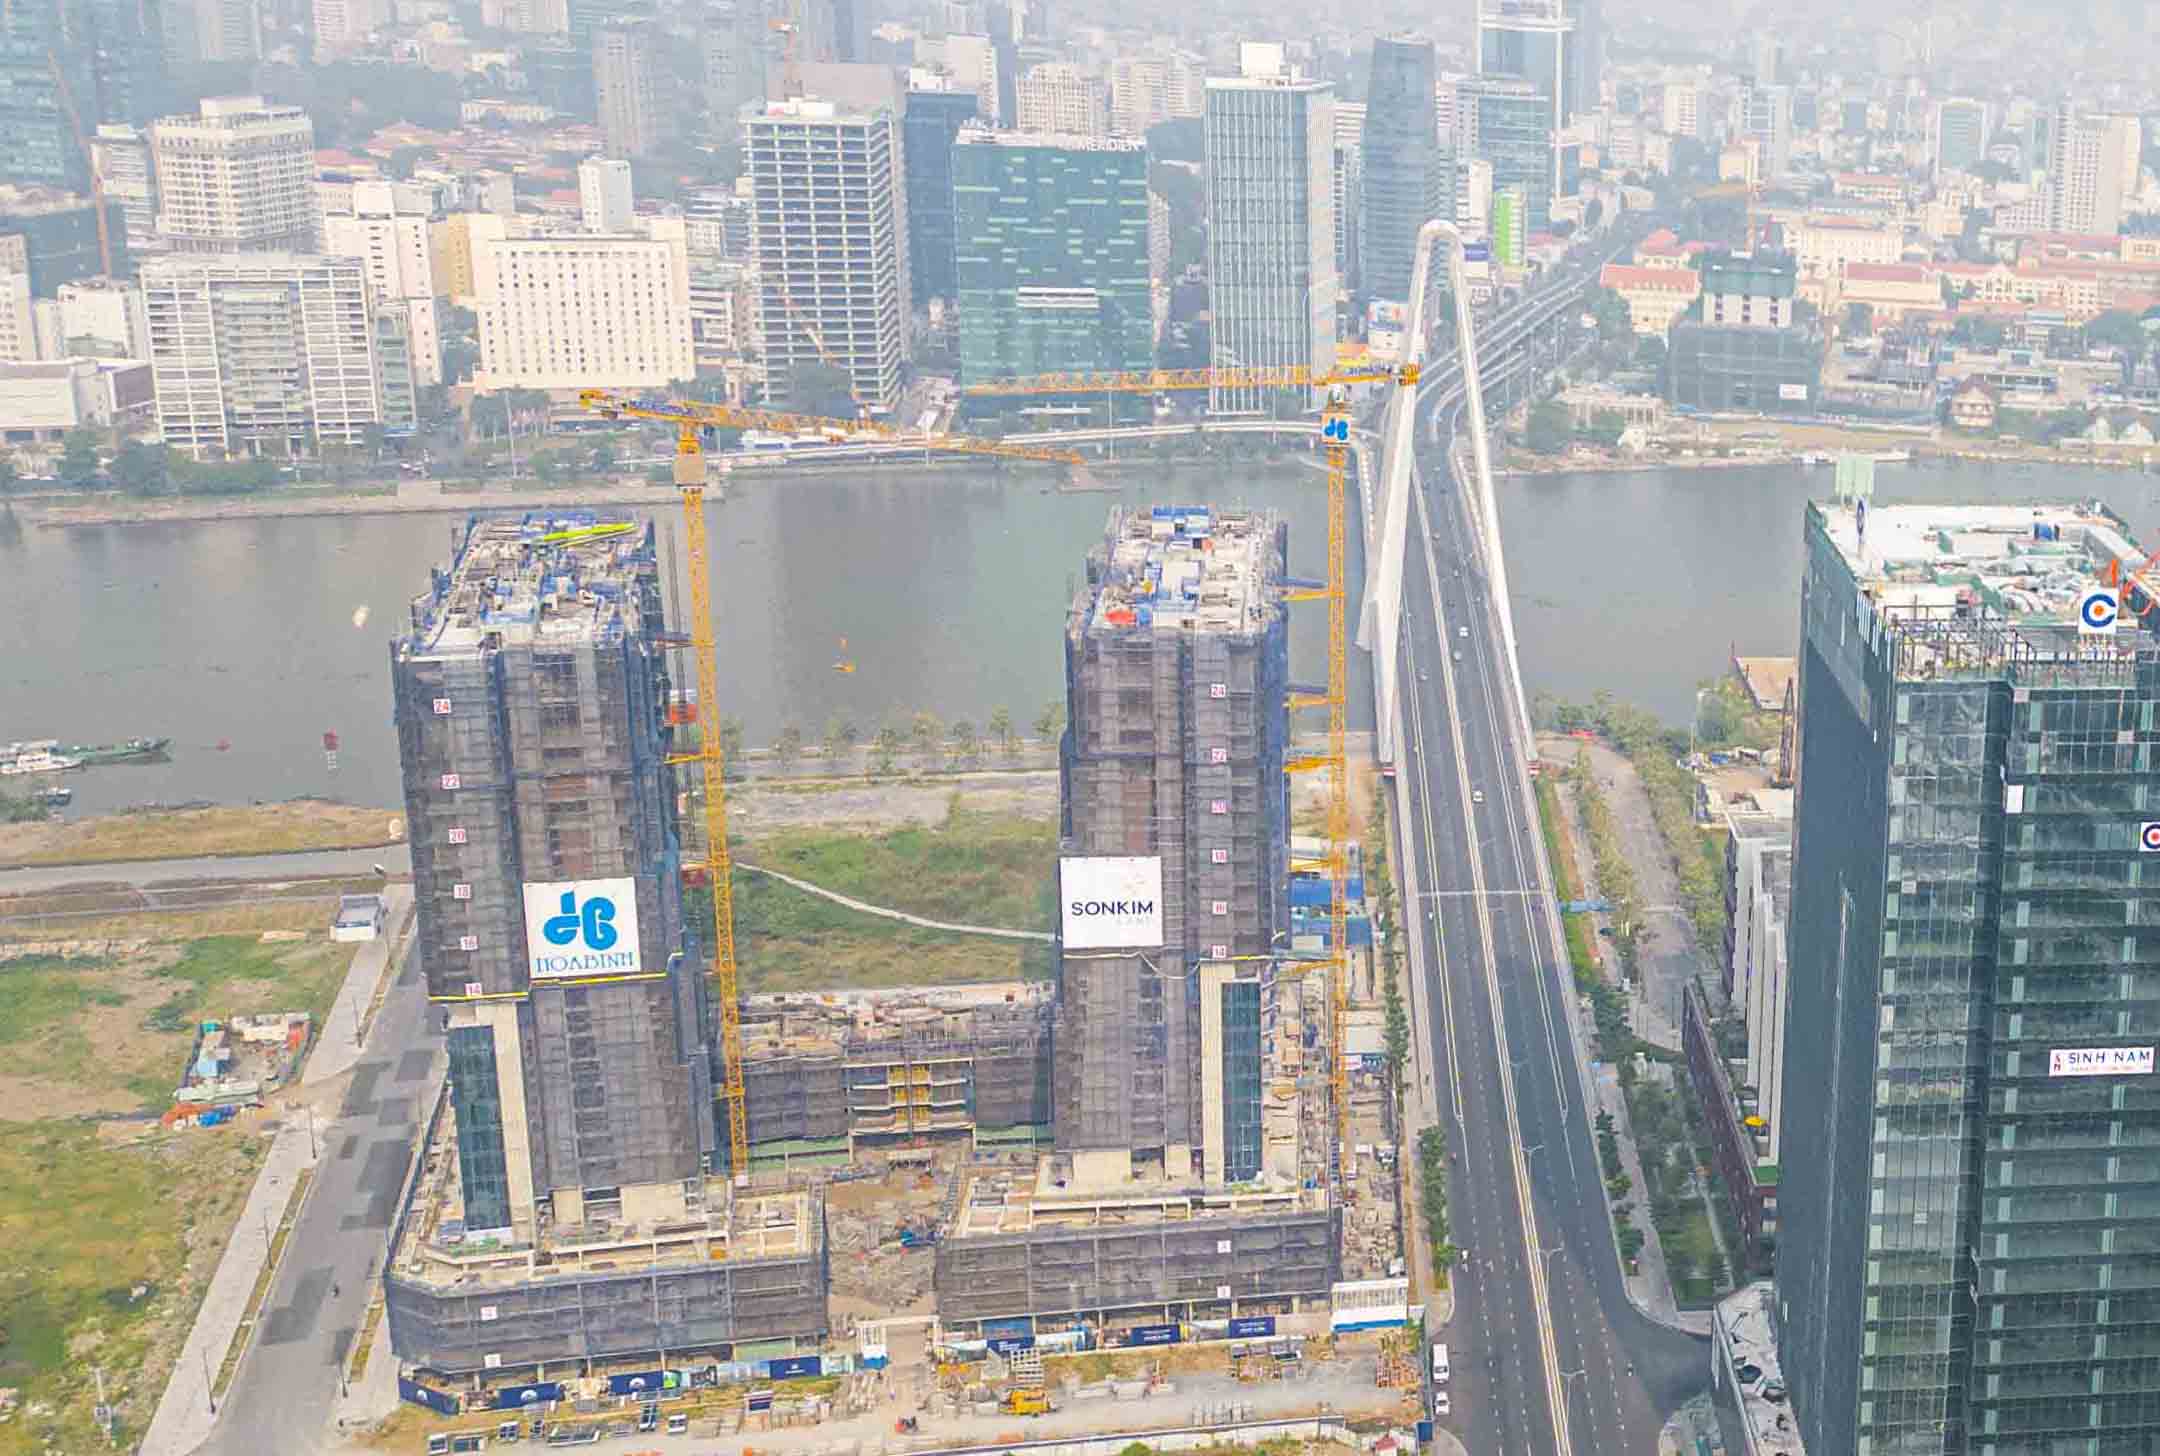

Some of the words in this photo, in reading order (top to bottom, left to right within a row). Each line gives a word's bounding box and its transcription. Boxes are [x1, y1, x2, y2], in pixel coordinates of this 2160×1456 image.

[1071, 900, 1153, 916] SONKIM
[2068, 1051, 2105, 1064] SINH
[2114, 1051, 2150, 1063] NAM
